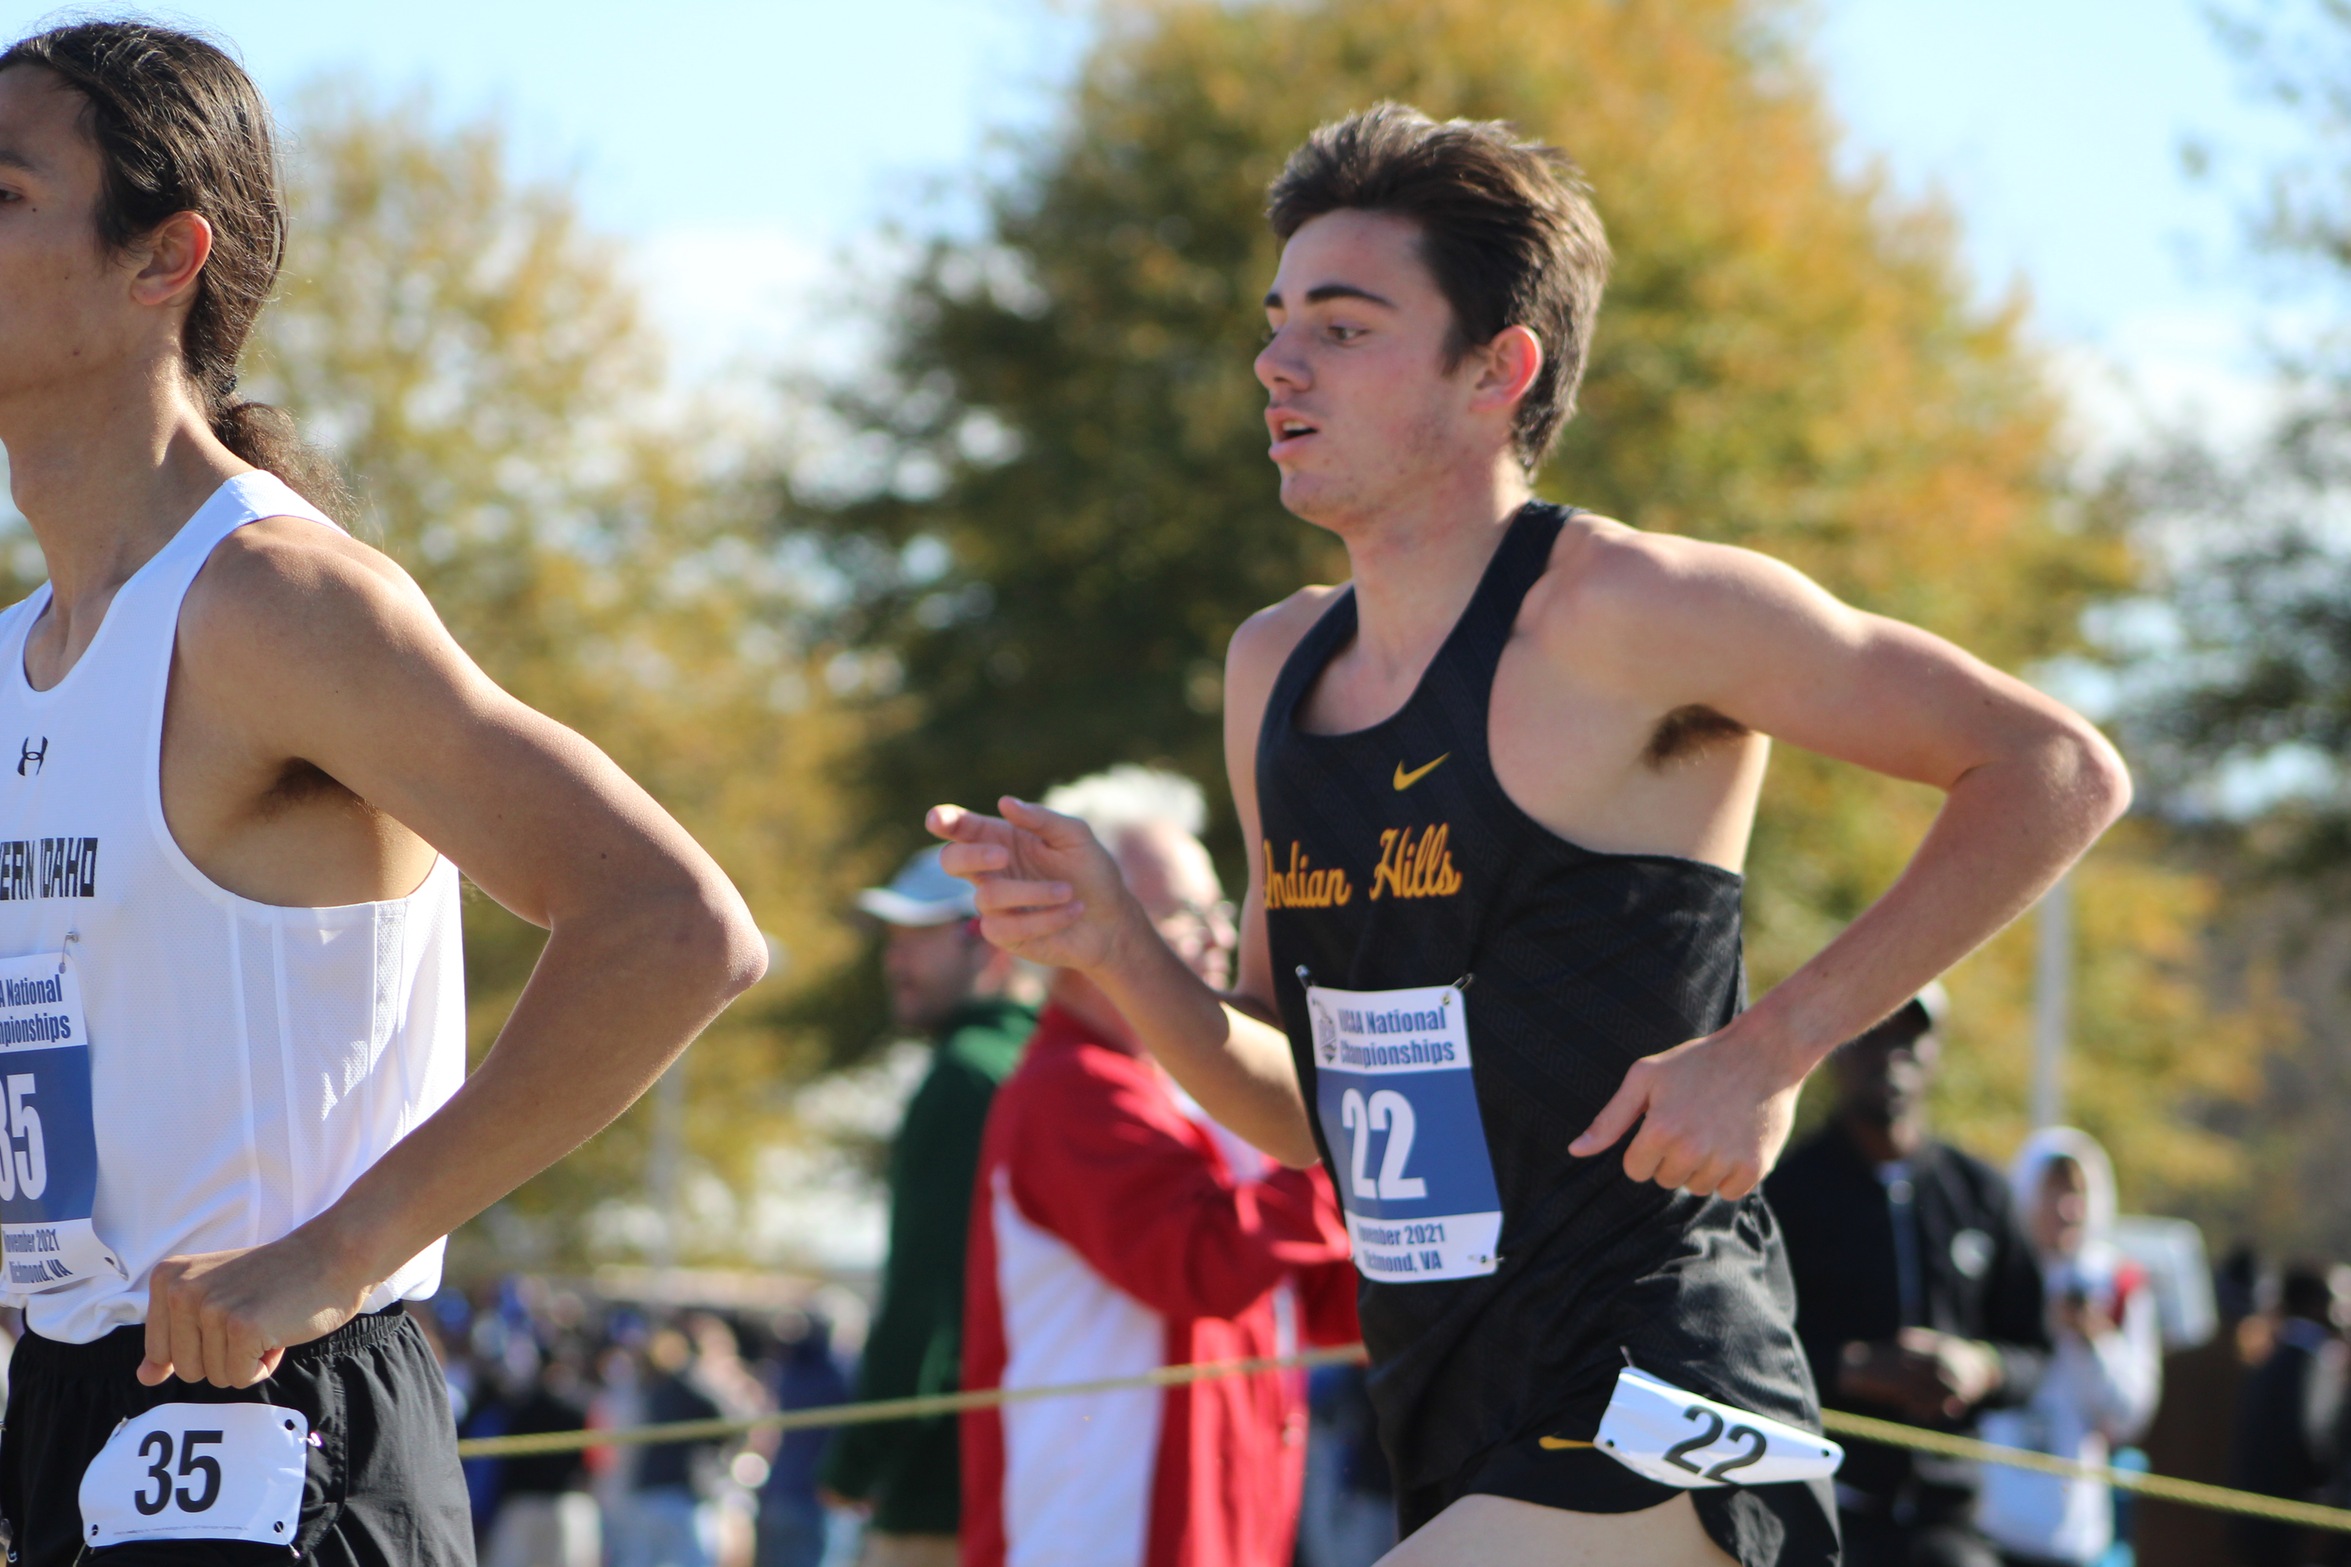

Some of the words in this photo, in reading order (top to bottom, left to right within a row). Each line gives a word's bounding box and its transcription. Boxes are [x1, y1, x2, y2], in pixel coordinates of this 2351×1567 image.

[40, 837, 98, 898] IDAHO
[1263, 839, 1352, 909] Indian
[1369, 822, 1463, 900] Hills
[6, 974, 62, 1006] National
[1365, 1006, 1446, 1034] National
[1341, 1088, 1427, 1200] 22
[36, 1228, 60, 1252] 2021
[1404, 1223, 1445, 1244] 2021
[46, 1259, 73, 1278] VA
[1418, 1250, 1442, 1270] VA
[1663, 1405, 1767, 1486] 22
[134, 1430, 223, 1516] 35
